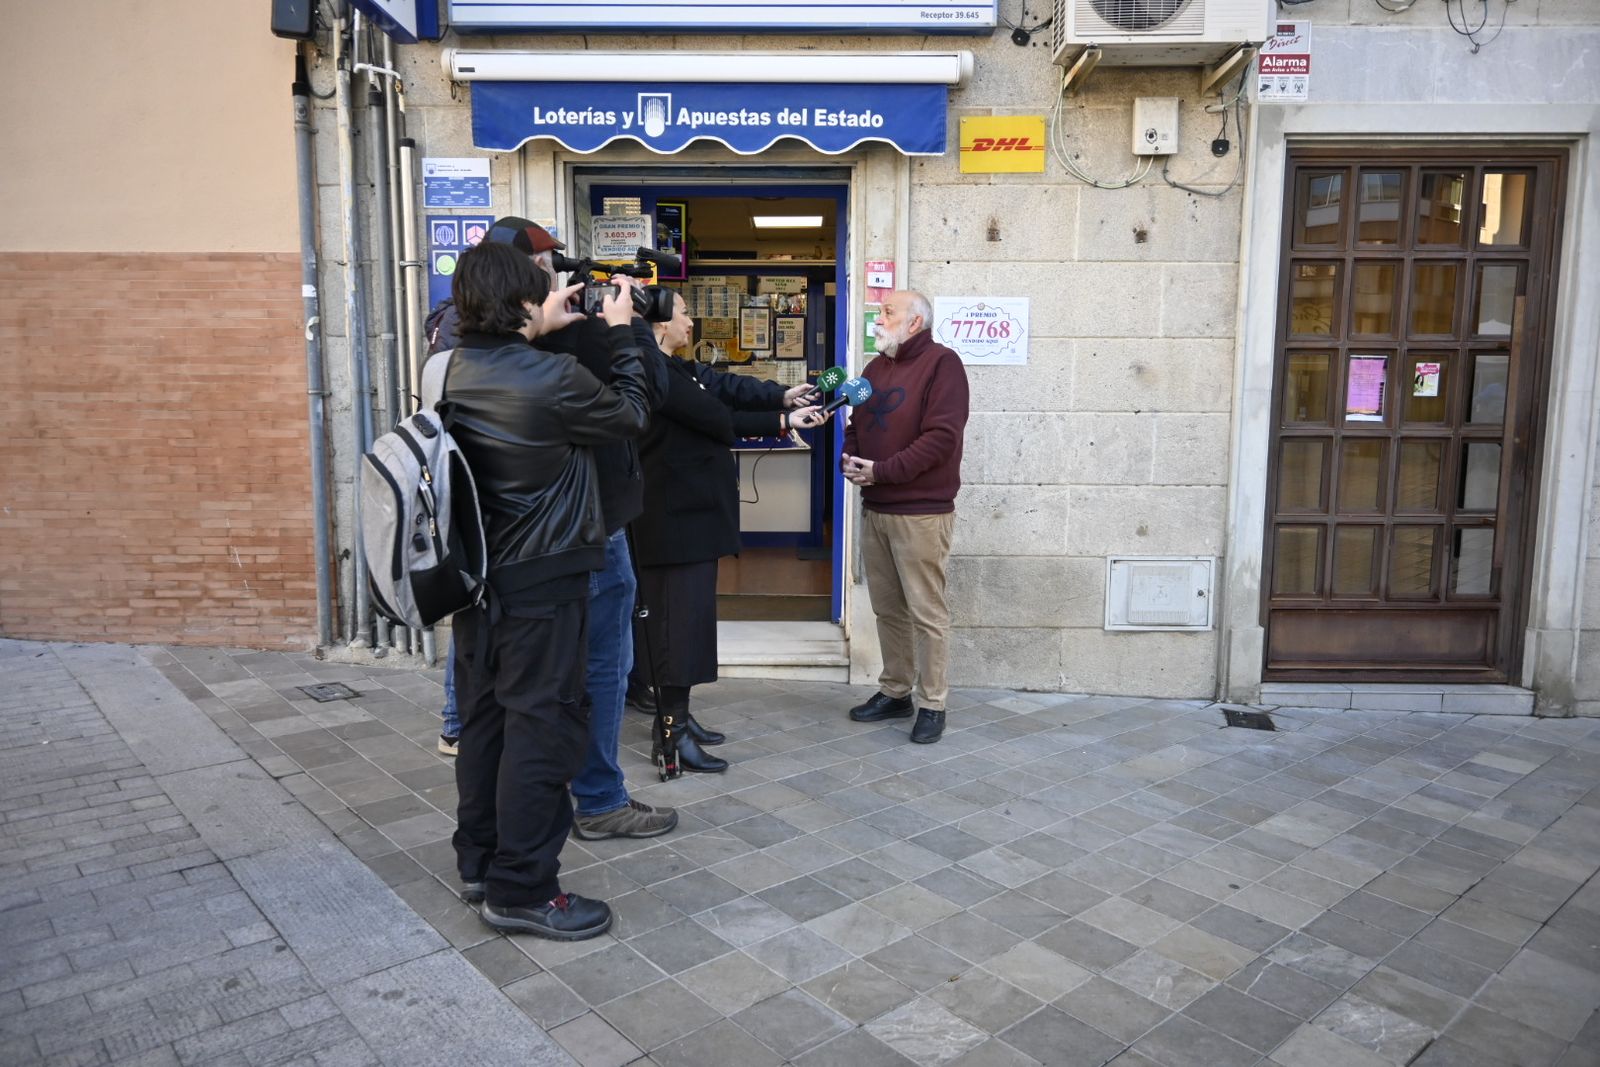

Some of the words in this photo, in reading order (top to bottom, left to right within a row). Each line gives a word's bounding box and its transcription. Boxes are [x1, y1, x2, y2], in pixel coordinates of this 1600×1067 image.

[920, 11, 953, 20] Receptor
[955, 11, 979, 19] 39.645
[1262, 56, 1307, 67] Alarma
[533, 107, 616, 125] Loterías
[622, 111, 634, 129] y
[676, 107, 771, 129] Apuestas
[777, 107, 807, 126] del
[814, 108, 884, 128] Estado
[971, 137, 1034, 152] DHL
[950, 320, 1011, 339] 77768
